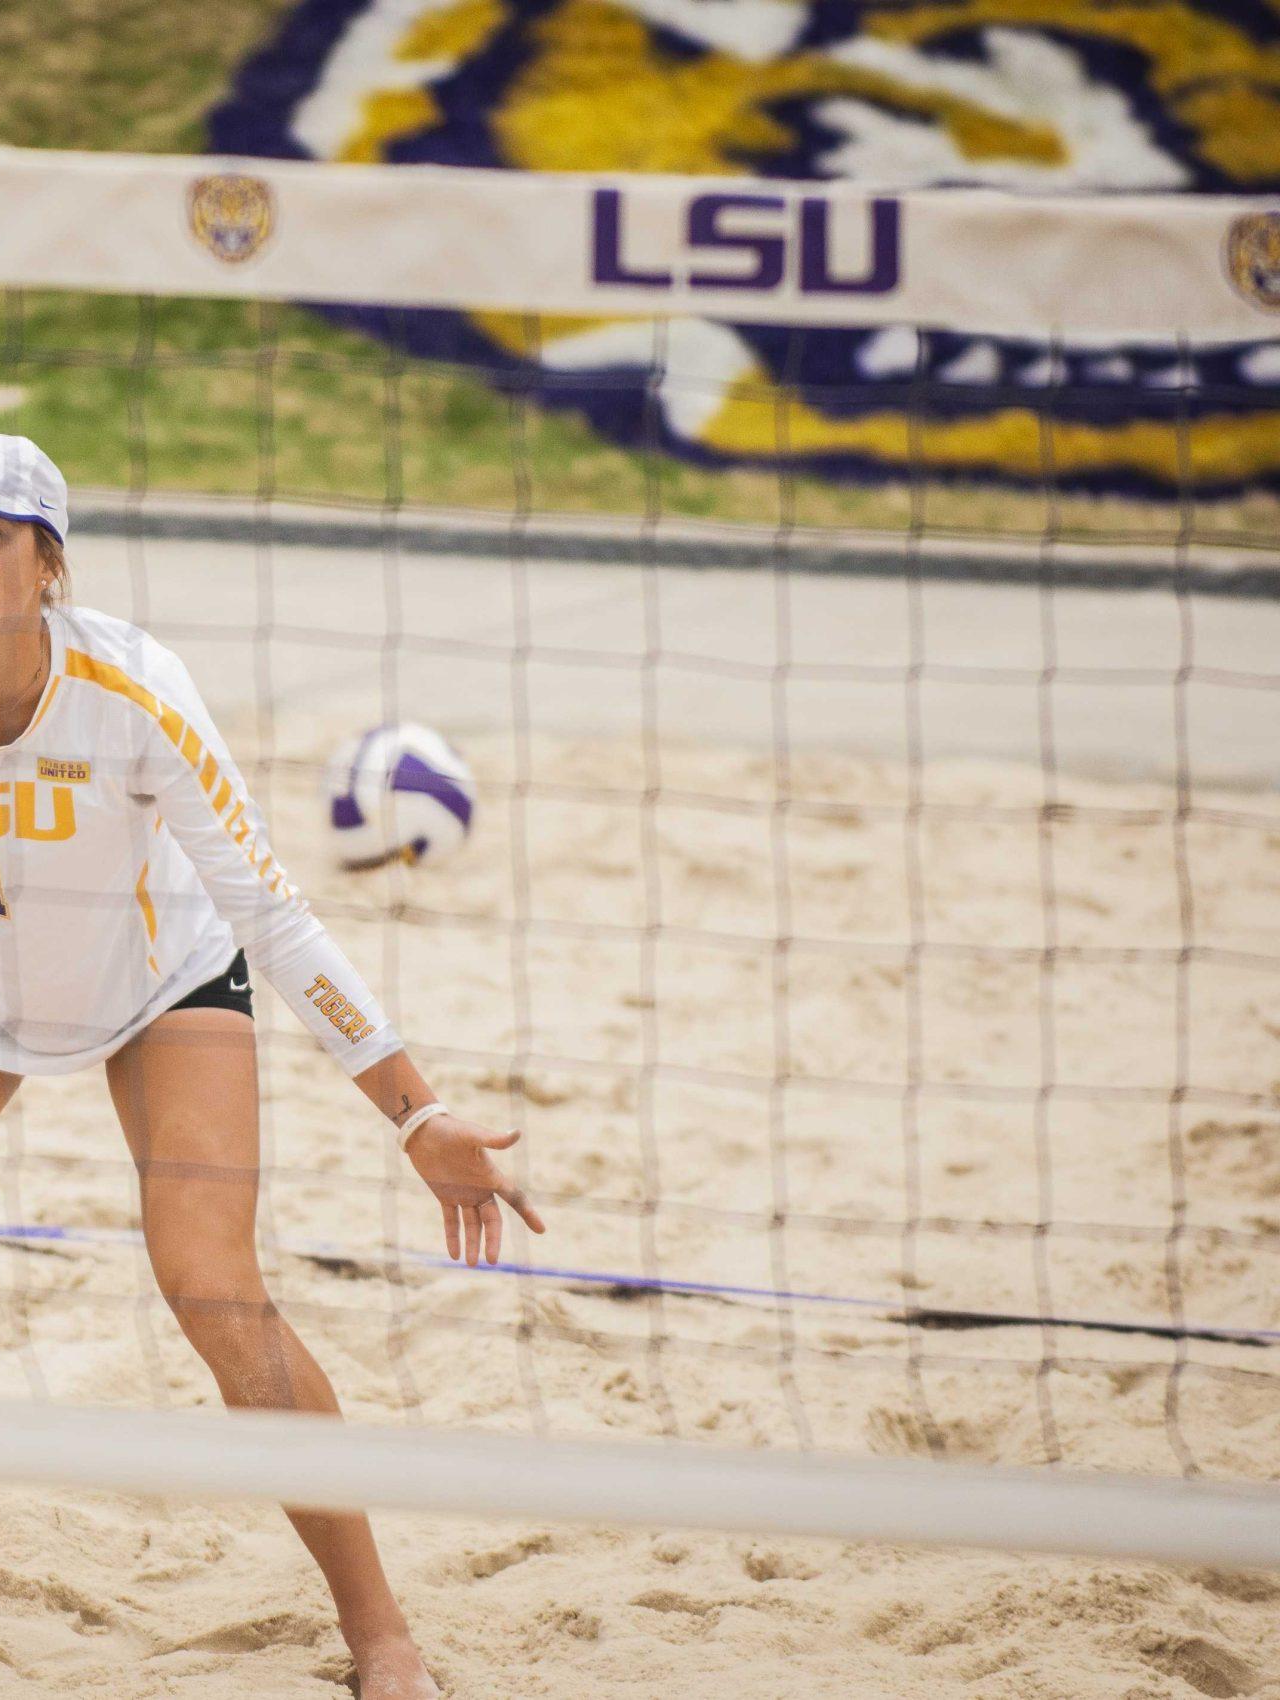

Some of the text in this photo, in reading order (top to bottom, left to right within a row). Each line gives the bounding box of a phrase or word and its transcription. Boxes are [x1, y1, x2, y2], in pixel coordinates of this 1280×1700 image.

[591, 187, 902, 295] LSU
[40, 767, 86, 778] UNITED
[304, 973, 377, 1046] TIGERS
